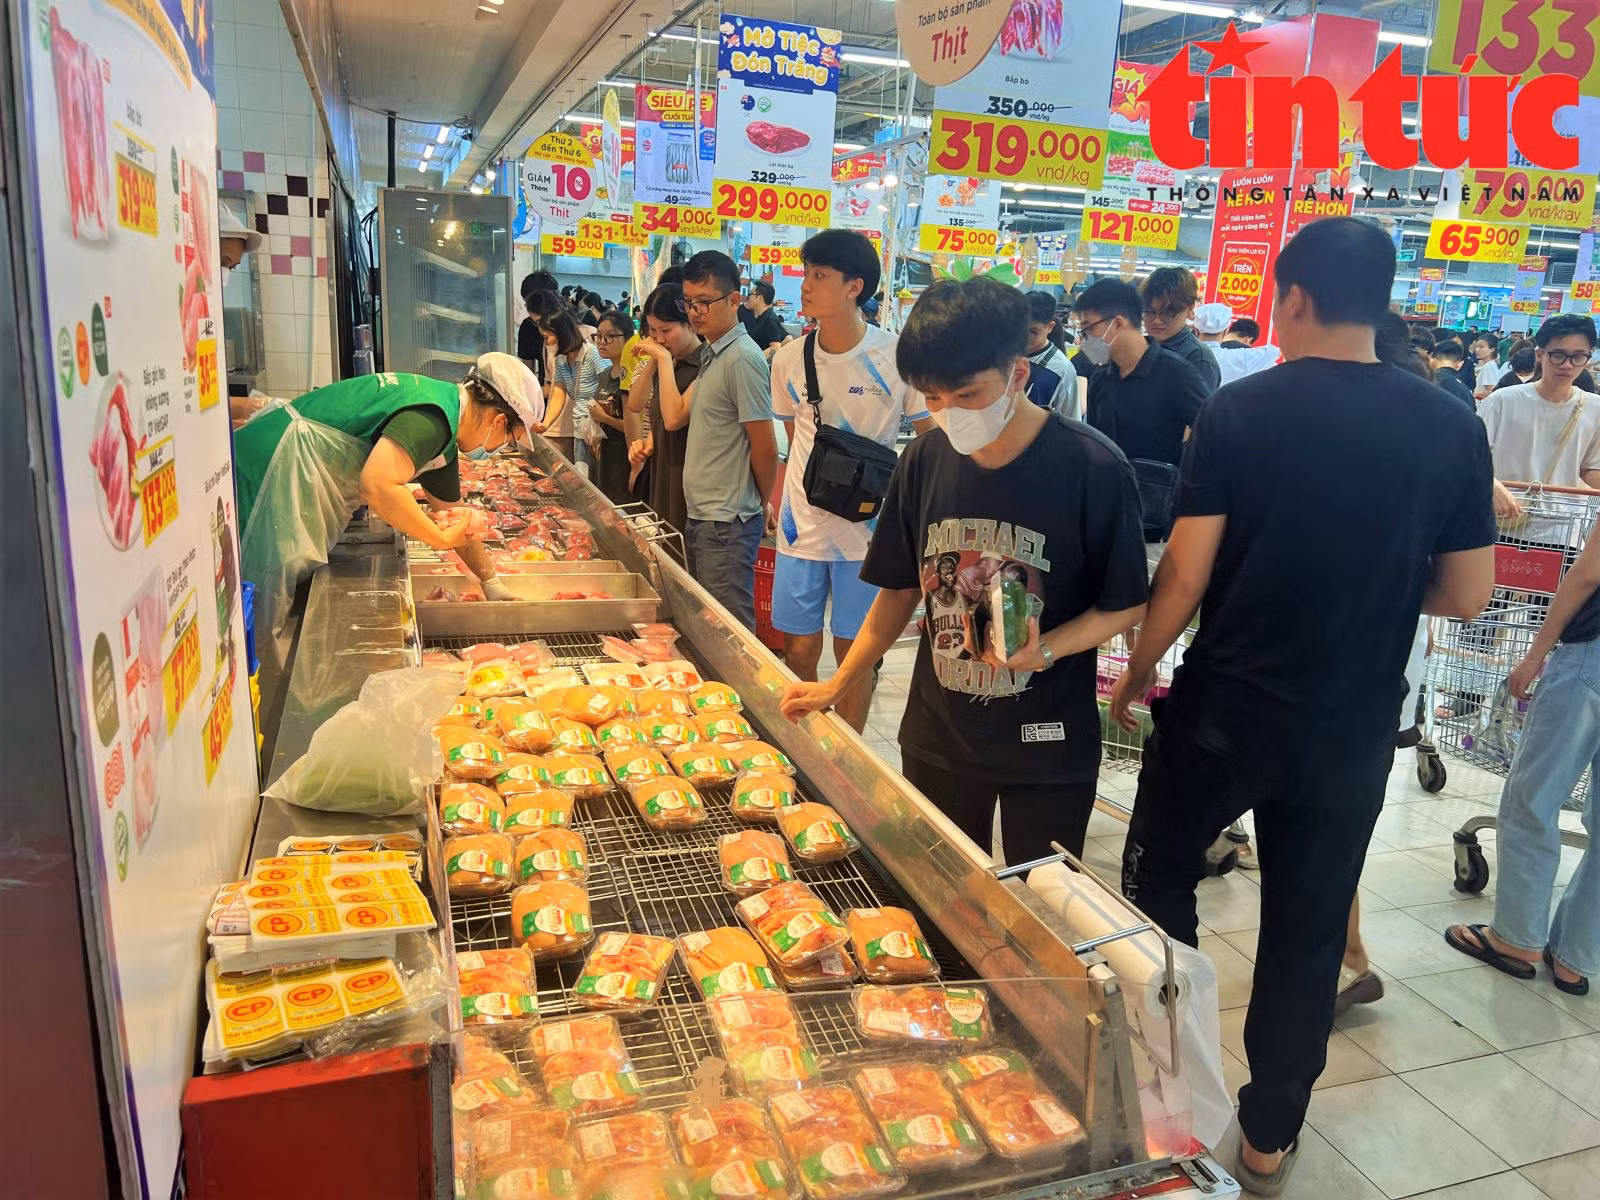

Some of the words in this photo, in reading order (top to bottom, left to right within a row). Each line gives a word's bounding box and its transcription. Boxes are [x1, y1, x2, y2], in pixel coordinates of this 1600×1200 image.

[918, 13, 935, 28] Toàn
[938, 9, 949, 23] bộ
[950, 3, 965, 17] sản
[743, 26, 775, 48] Mở
[778, 30, 820, 57] Tiệc
[931, 25, 969, 64] Thịt
[730, 51, 771, 74] Đón
[1005, 76, 1018, 85] Bắp
[1020, 77, 1029, 85] bò
[651, 93, 683, 108] SIÊU
[987, 95, 1055, 117] 350.000
[1029, 113, 1050, 122] vnd/kg
[550, 134, 565, 145] Thứ
[936, 118, 1101, 176] 319.000
[541, 143, 557, 152] đến
[559, 146, 575, 156] Thứ
[527, 172, 551, 184] GIẢM
[751, 170, 795, 184] 329.000
[1037, 164, 1090, 186] vnd/kg
[1233, 177, 1252, 187] LUÔN
[1253, 174, 1274, 185] LUÔN
[531, 184, 548, 192] Thêm
[1472, 170, 1585, 218] 79.000
[665, 195, 691, 204] 49.000
[717, 184, 828, 221] 299.000
[550, 206, 570, 219] Thịt
[1315, 202, 1348, 216] HƠN
[1529, 205, 1581, 223] vnd/khay
[641, 206, 715, 233] 34.000
[785, 212, 821, 226] vnd/kg
[1089, 211, 1174, 242] 121.000
[552, 237, 602, 254] 59.000
[937, 229, 997, 252] 75.000
[1133, 234, 1172, 247] vnd/khay
[1440, 223, 1520, 256] 65.900
[1233, 262, 1253, 273] TRÊN
[1220, 276, 1259, 293] 2.000
[924, 518, 1050, 573] MICHAEL
[261, 886, 279, 897] CP
[271, 917, 290, 934] CP
[358, 909, 377, 926] CP
[352, 974, 383, 988] CP
[293, 988, 326, 1001] CP
[232, 1002, 266, 1016] CP
